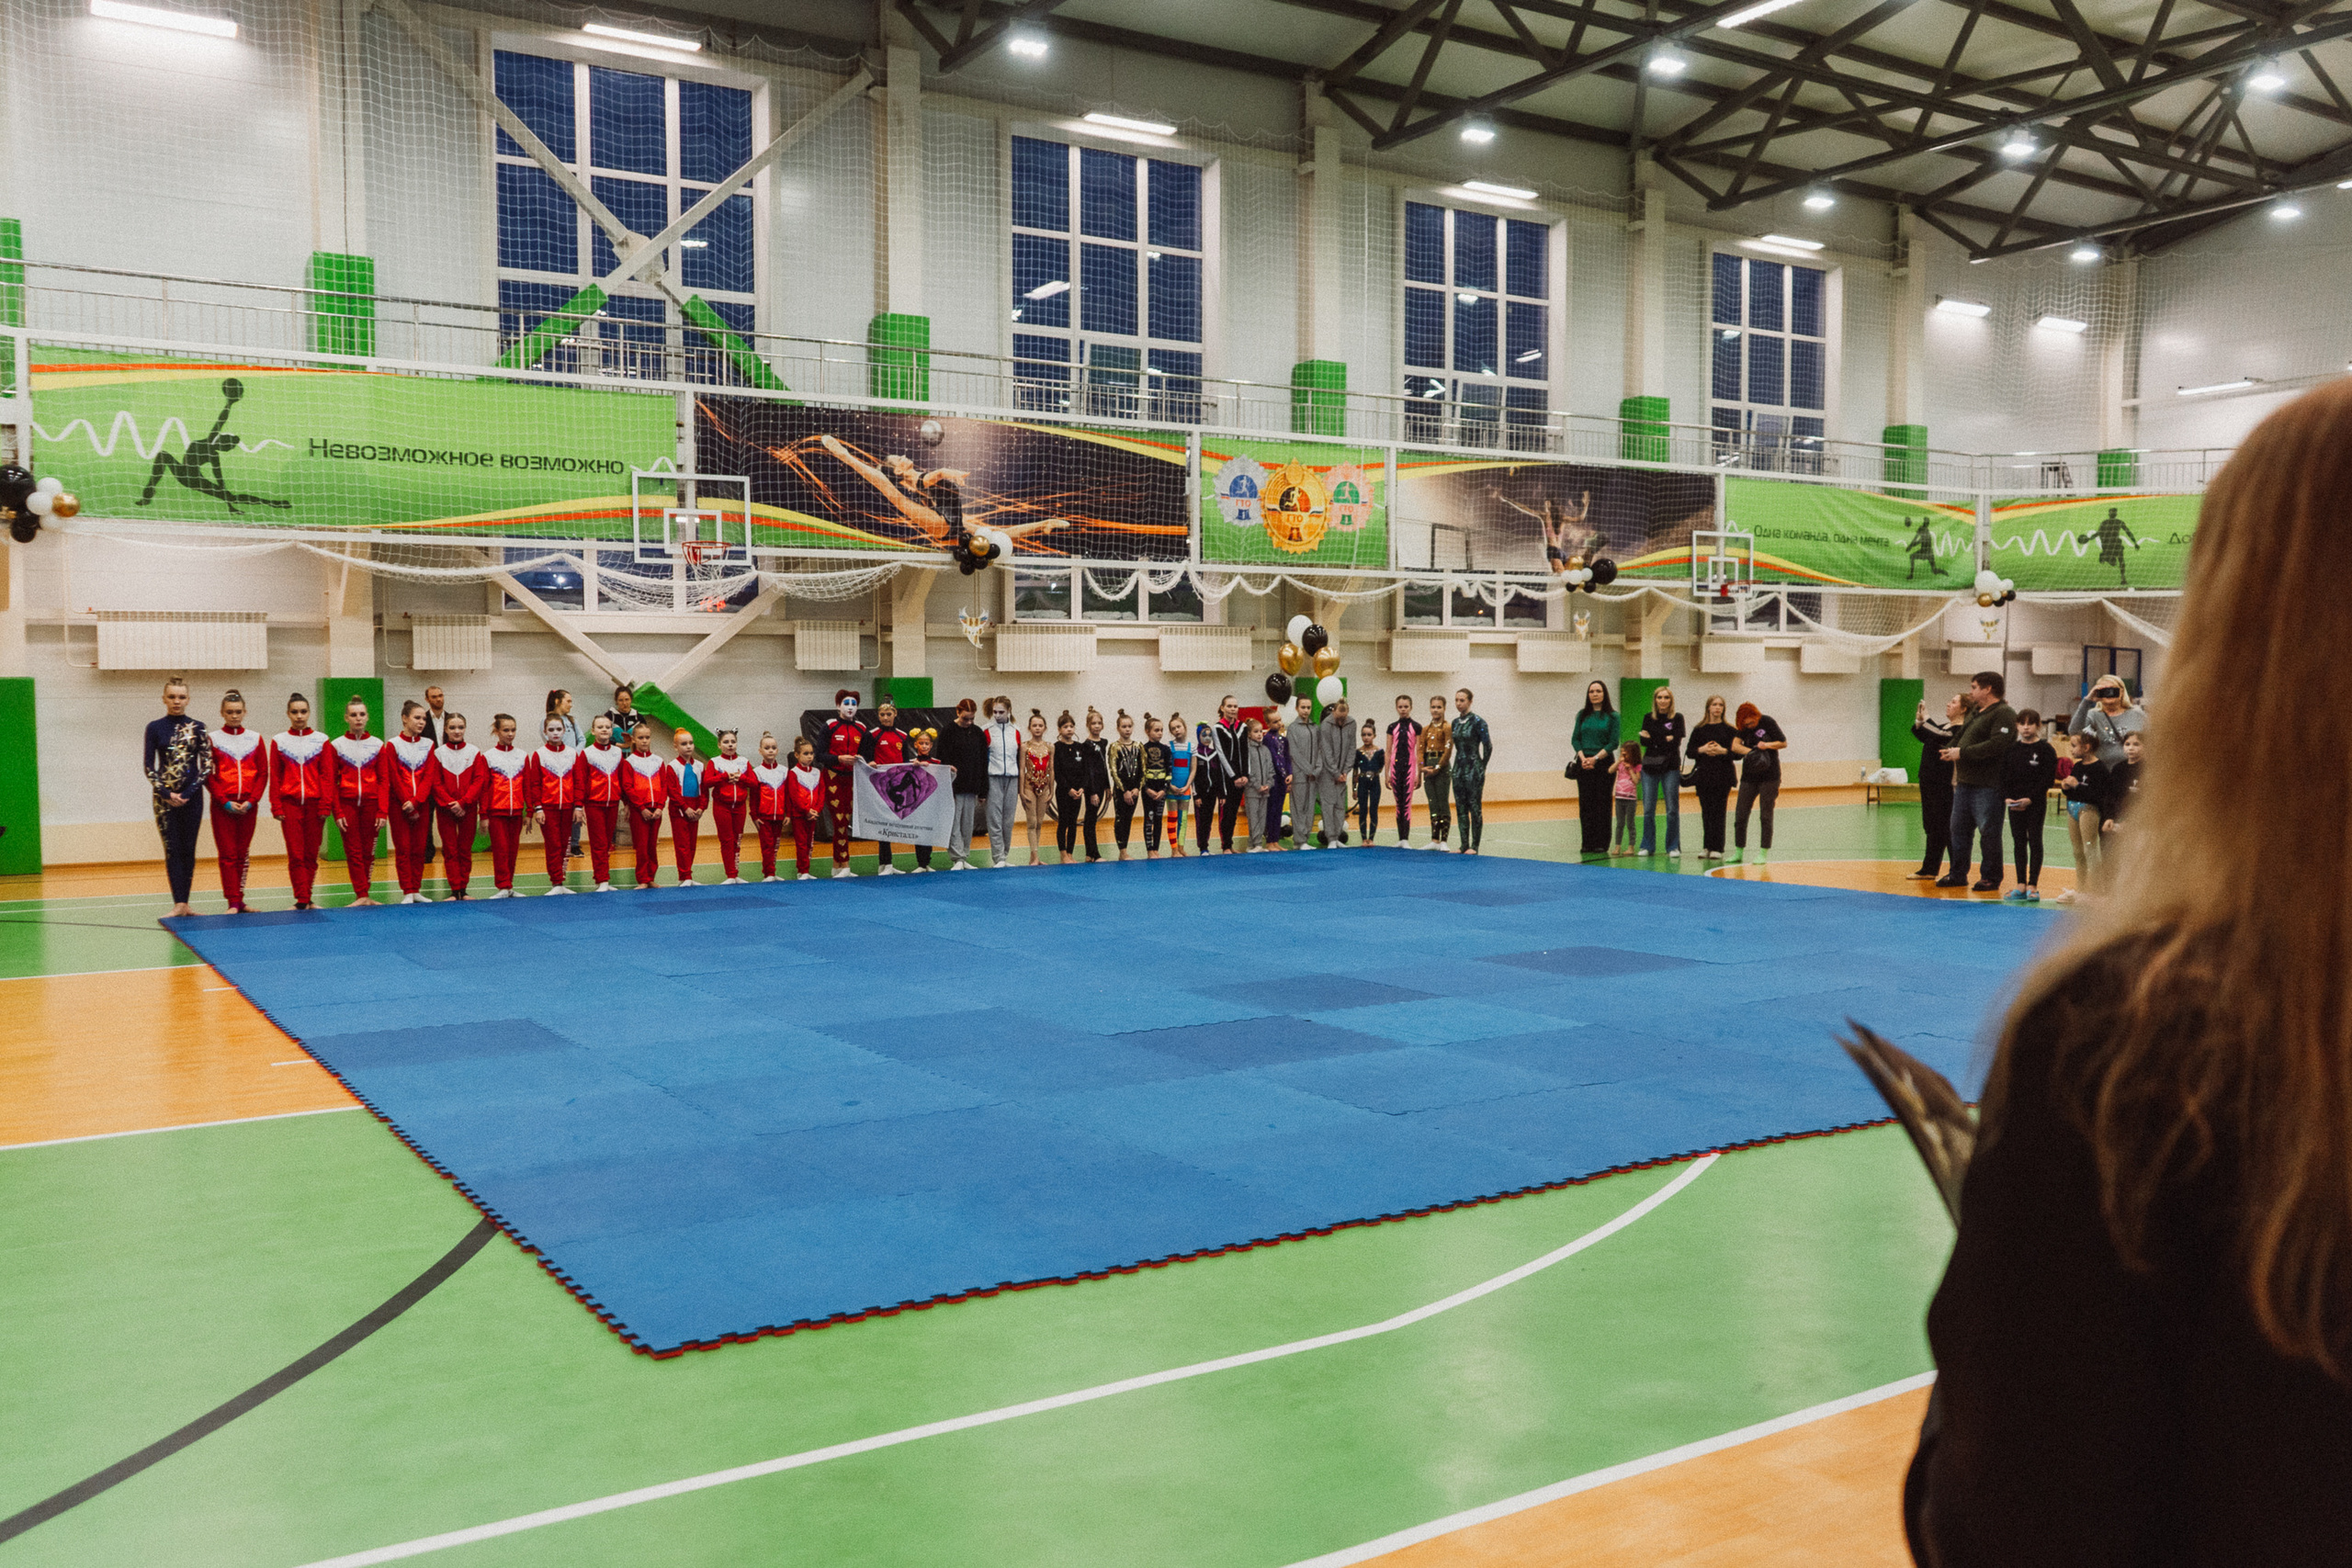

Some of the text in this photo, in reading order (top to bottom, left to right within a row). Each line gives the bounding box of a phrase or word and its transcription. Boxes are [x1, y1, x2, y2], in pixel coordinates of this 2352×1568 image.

[309, 437, 625, 475] Невозможное возможно
[1236, 499, 1251, 507] ГТО
[1286, 513, 1303, 523] ГТО
[1754, 525, 1781, 539] Одна
[1833, 533, 1858, 544] одна
[1860, 536, 1890, 547] мечта
